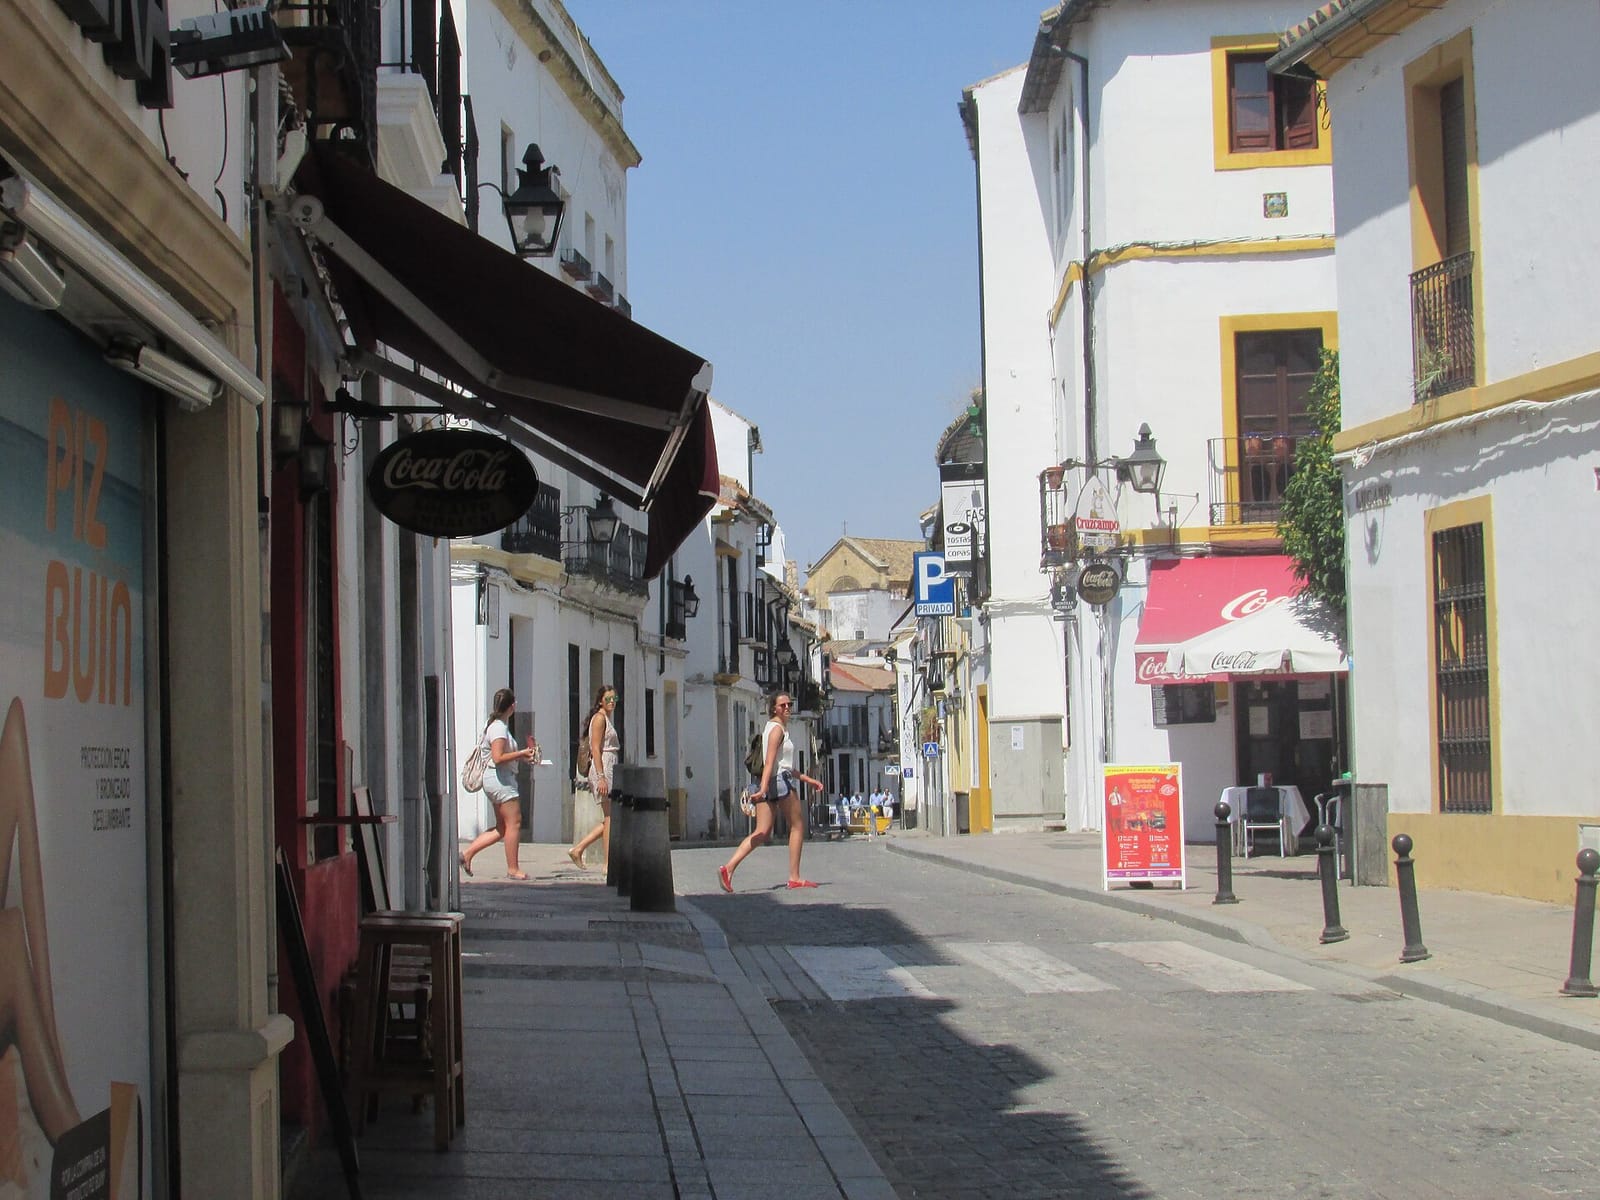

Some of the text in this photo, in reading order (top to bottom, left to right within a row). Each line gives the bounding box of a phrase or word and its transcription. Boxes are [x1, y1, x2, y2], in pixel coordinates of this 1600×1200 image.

[46, 396, 108, 549] PIZ
[1076, 517, 1120, 532] Cruzcampo
[918, 556, 948, 601] P
[918, 604, 952, 615] PRIVADO
[44, 560, 131, 706] BUIN
